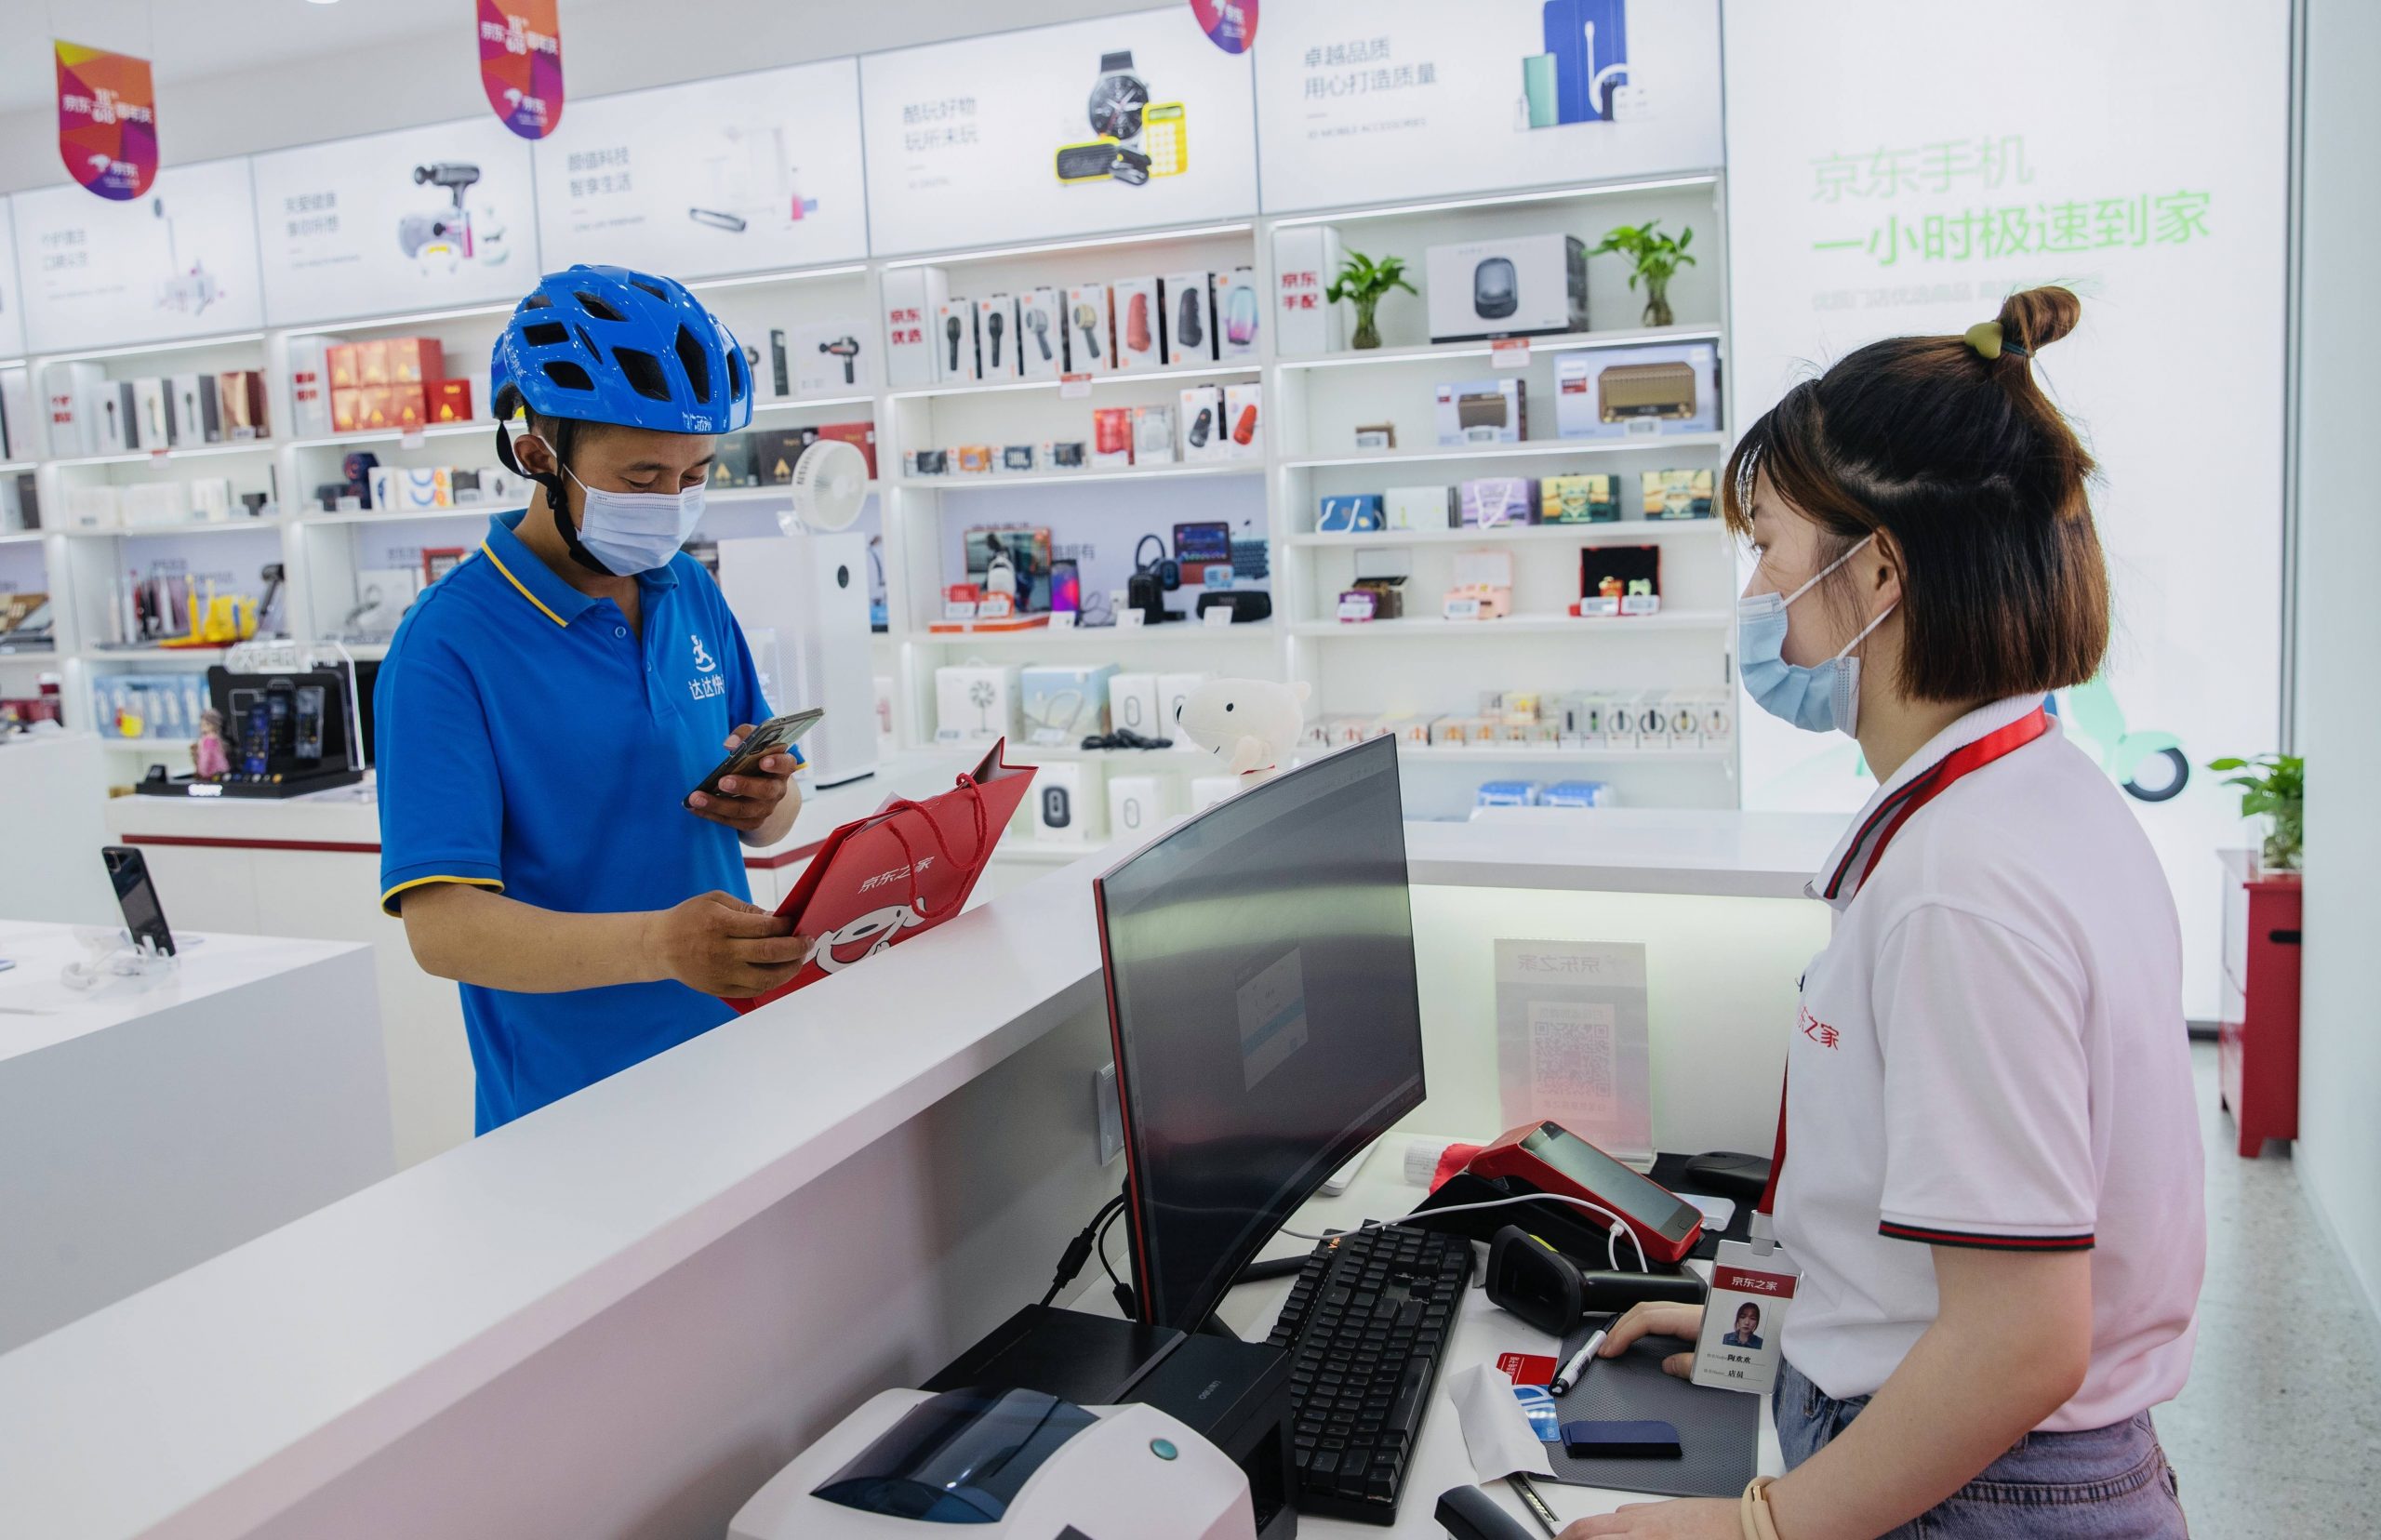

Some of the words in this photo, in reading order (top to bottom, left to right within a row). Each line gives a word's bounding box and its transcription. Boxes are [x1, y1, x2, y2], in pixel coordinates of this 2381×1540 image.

[1304, 35, 1391, 68] 卓越品质
[1304, 61, 1437, 100] 用心打造质量
[902, 96, 978, 125] 酷玩好物
[1808, 134, 2035, 204] 京东手机
[1812, 189, 2212, 266] 一小时极速到家
[1282, 272, 1318, 289] 京东
[1283, 293, 1318, 311] 手配
[889, 308, 923, 325] 京东
[891, 327, 923, 345] 优选
[688, 673, 725, 699] 达达快
[858, 856, 936, 894] 京东之家
[1731, 1275, 1778, 1292] 京东之家
